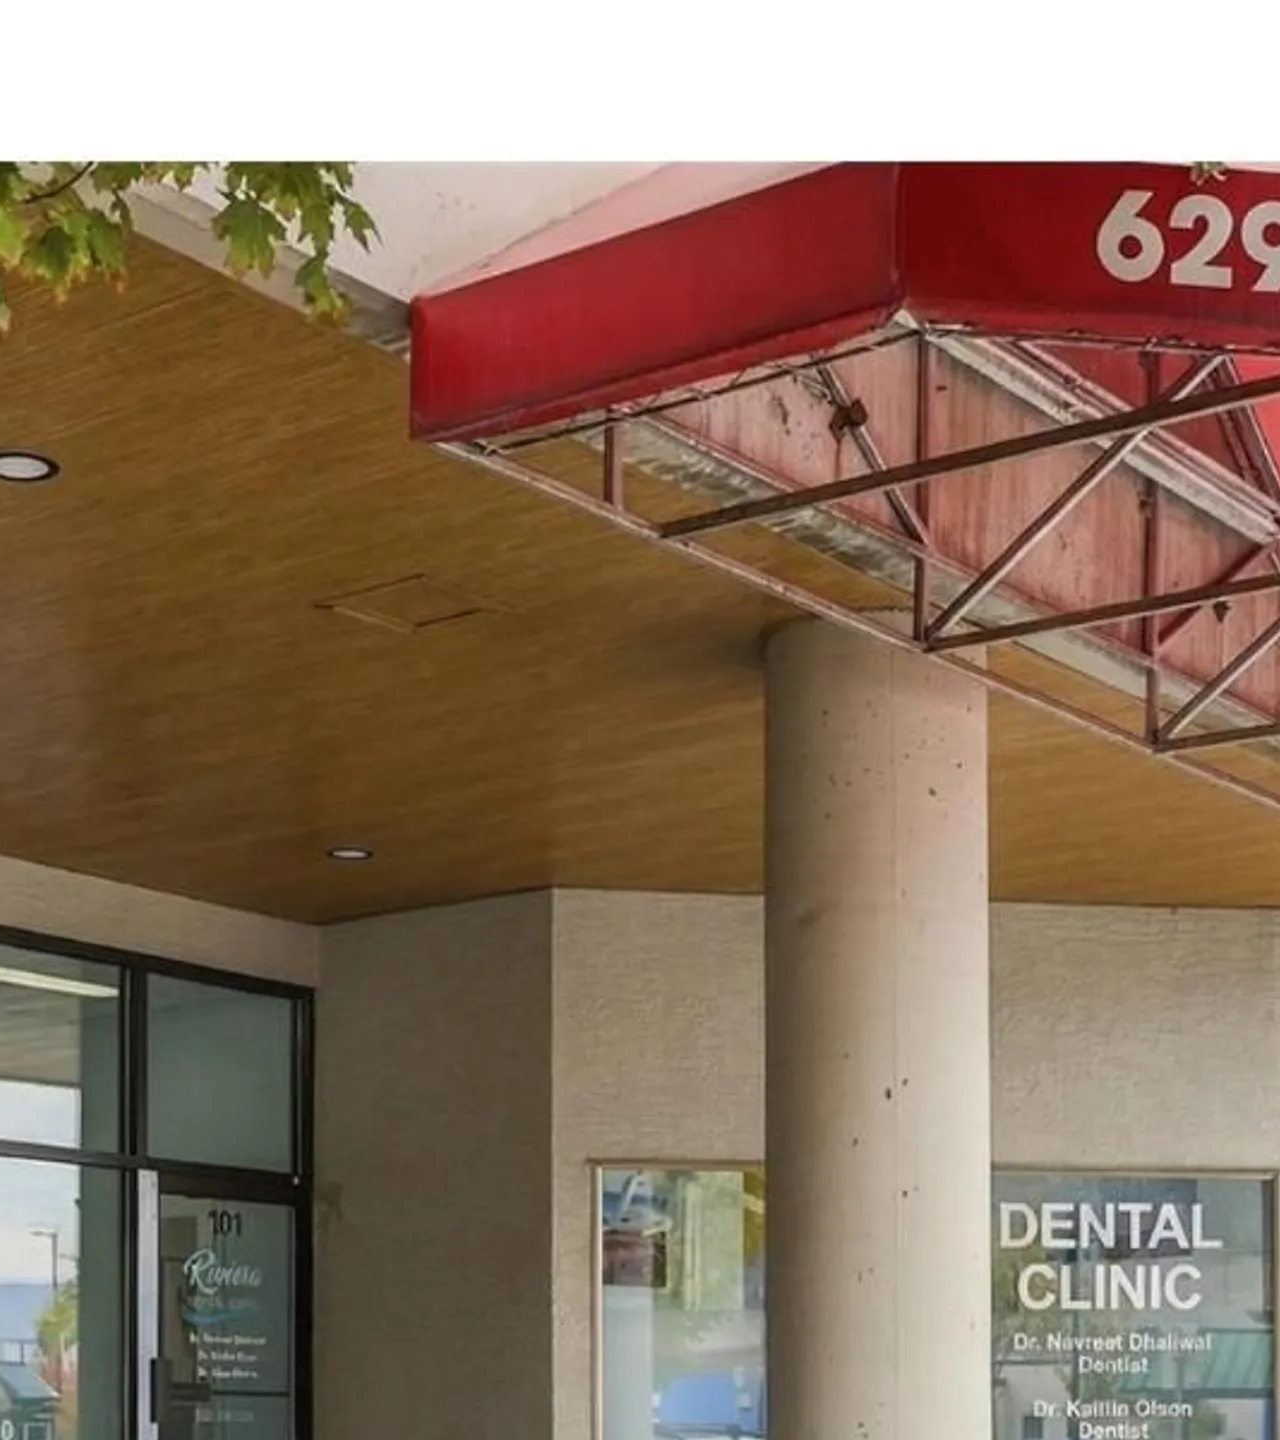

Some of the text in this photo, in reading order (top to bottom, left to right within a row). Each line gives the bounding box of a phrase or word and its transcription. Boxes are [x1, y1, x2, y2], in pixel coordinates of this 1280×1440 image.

[208, 1209, 242, 1237] 101
[999, 1202, 1224, 1249] DENTAL
[1018, 1264, 1202, 1310] CLINIC
[1078, 1355, 1148, 1374] Dentist
[1079, 1421, 1149, 1440] Dentist
